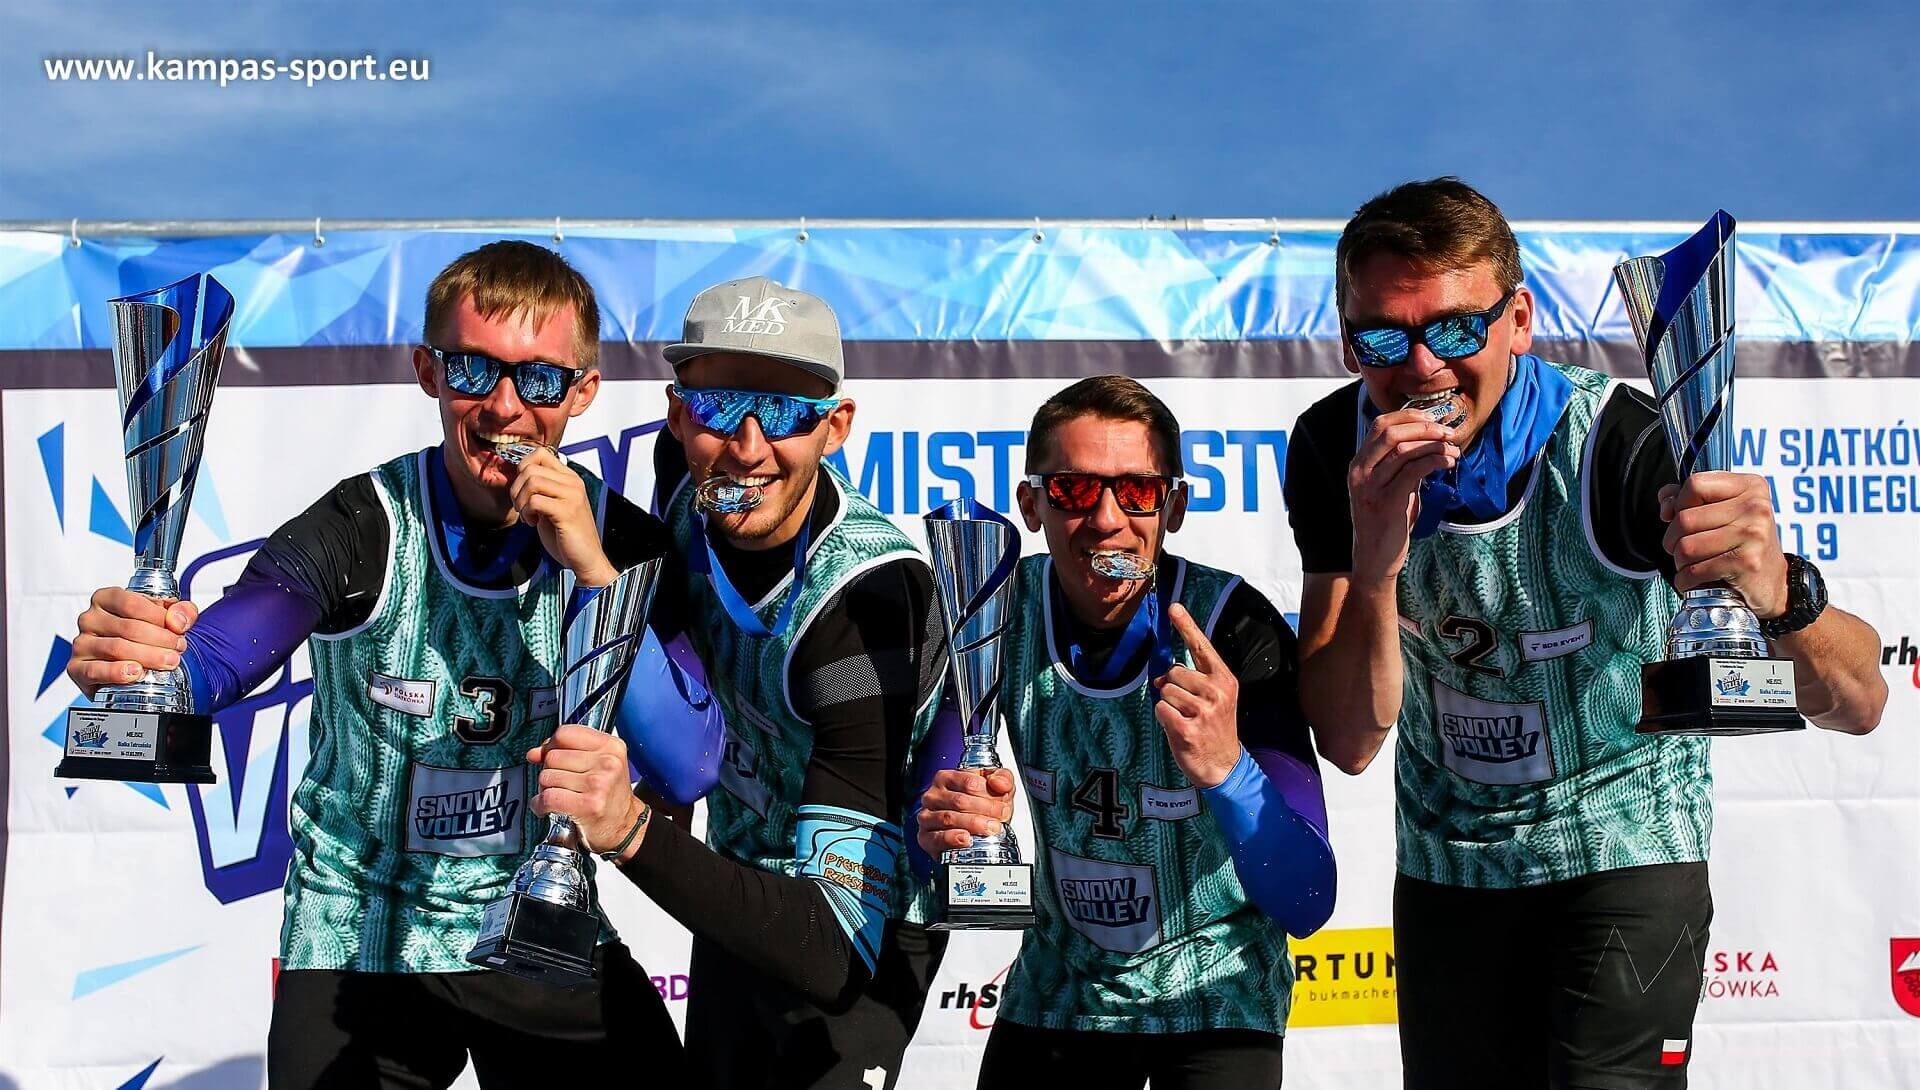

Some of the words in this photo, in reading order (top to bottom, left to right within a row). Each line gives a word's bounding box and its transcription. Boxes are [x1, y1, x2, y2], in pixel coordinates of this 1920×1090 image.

[724, 295, 792, 324] MK
[721, 320, 785, 335] MED
[1438, 615, 1505, 679] 2
[1560, 633, 1585, 647] EVENT
[394, 686, 425, 699] POLSKA
[453, 675, 514, 743] 3
[1441, 713, 1524, 739] SNOW
[1444, 731, 1540, 763] VOLLEY
[418, 782, 508, 818] SNOW
[1072, 767, 1130, 840] 4
[1170, 799, 1193, 808] EVENT
[415, 800, 519, 840] VOLLEY
[1061, 878, 1136, 901] SNOW
[1064, 896, 1150, 927] VOLLEY
[1704, 952, 1779, 973] SKA
